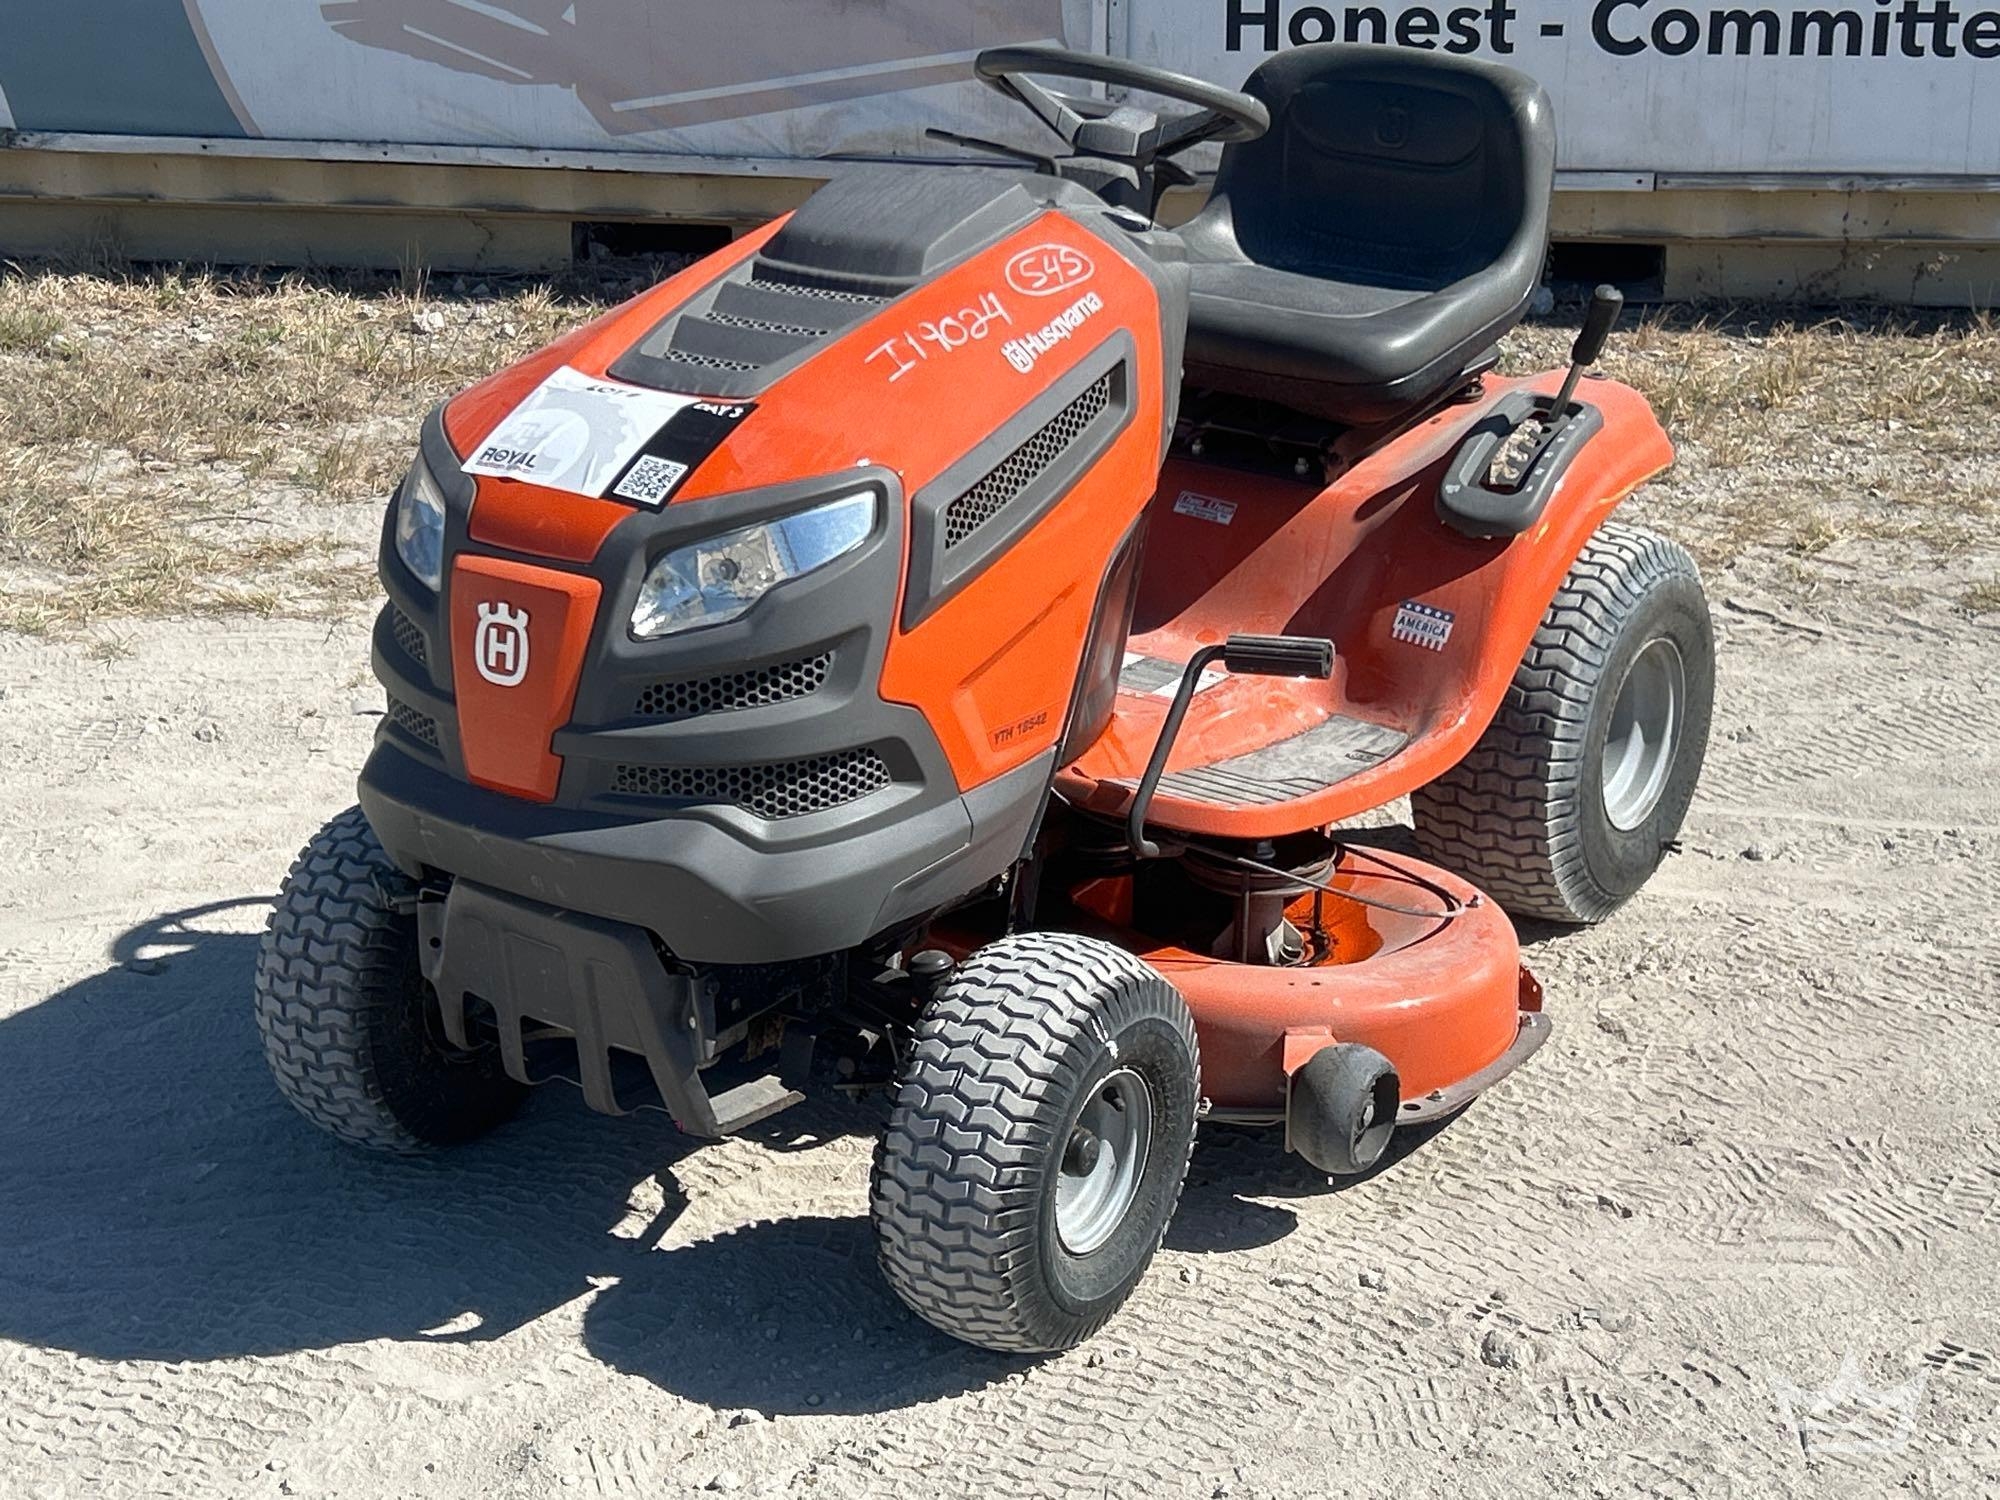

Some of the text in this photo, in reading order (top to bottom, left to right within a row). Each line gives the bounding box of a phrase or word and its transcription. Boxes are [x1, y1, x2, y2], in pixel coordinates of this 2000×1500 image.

[1226, 0, 1517, 54] Honest
[1591, 0, 2000, 58] Committe
[1022, 291, 1105, 362] Husqvarna
[479, 447, 537, 469] ROYAL
[1397, 615, 1447, 639] AMERICA
[993, 725, 1015, 745] YTH
